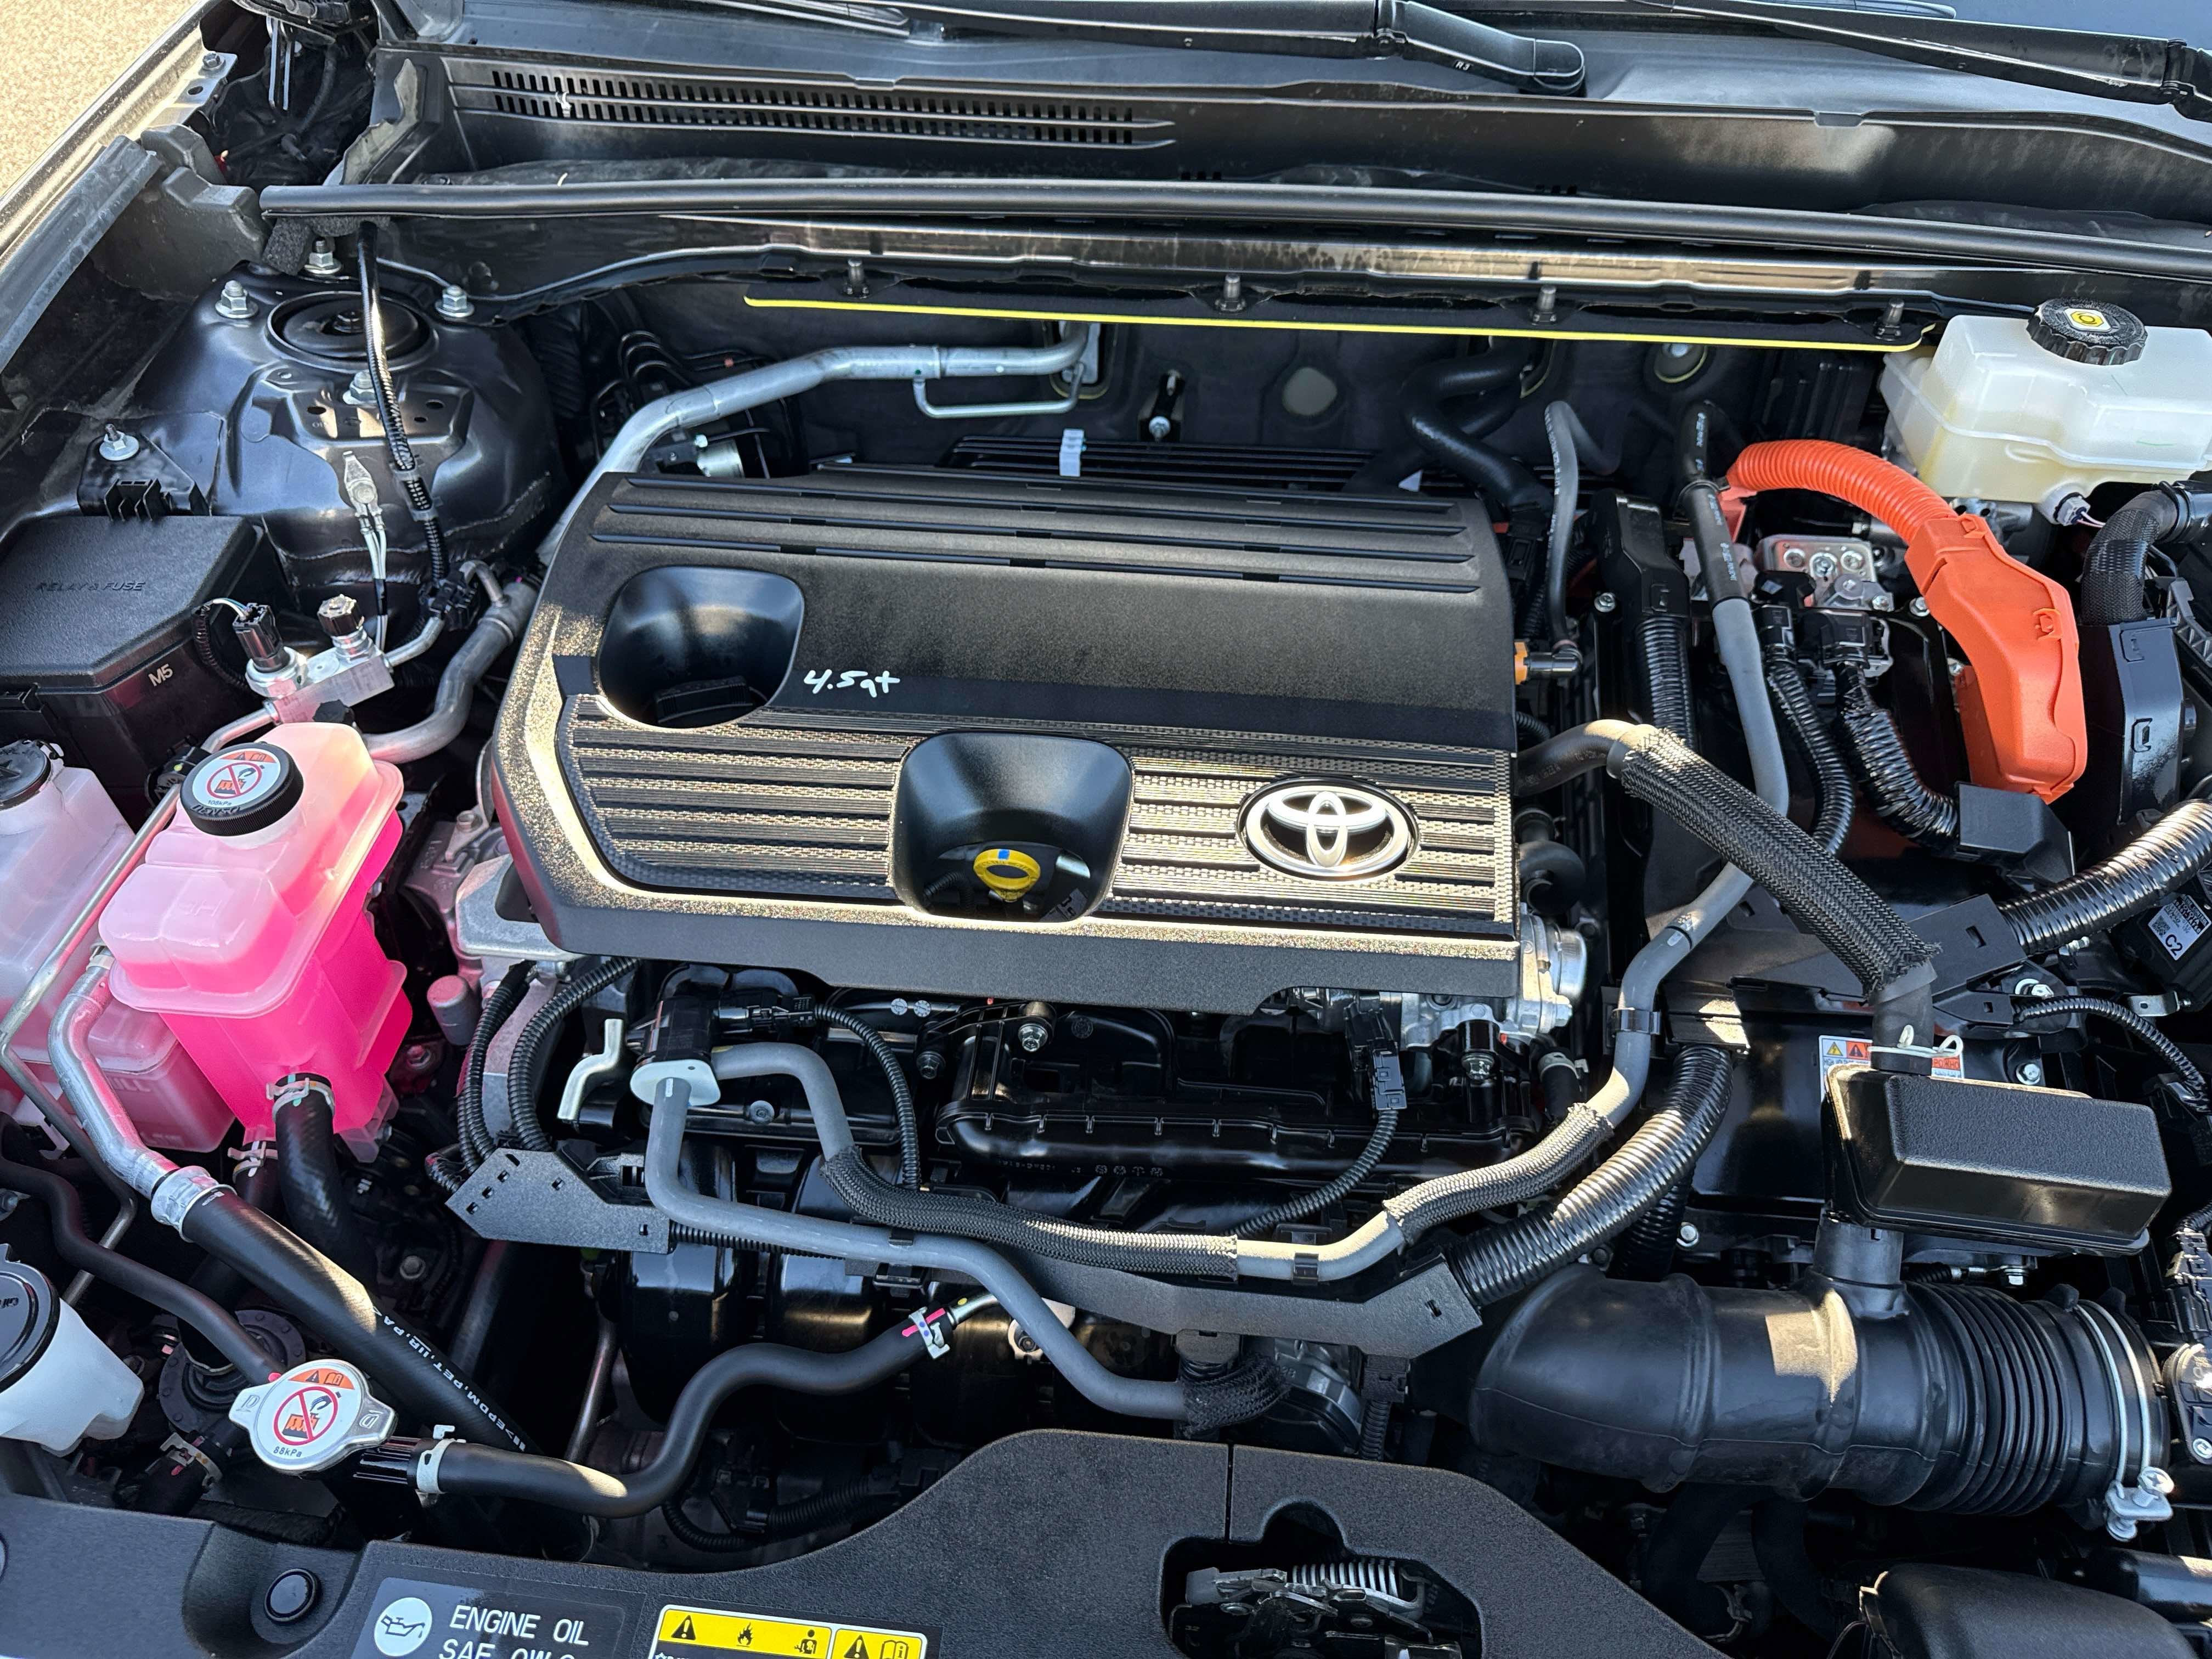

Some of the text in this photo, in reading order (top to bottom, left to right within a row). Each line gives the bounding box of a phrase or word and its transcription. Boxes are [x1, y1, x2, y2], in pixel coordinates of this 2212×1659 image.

[103, 582, 145, 591] FUSE
[148, 663, 173, 687] M5
[2179, 901, 2201, 925] TOYOTA
[2165, 934, 2183, 956] C2
[273, 1446, 302, 1457] 88kPa
[449, 1605, 589, 1646] ENGINE OIL
